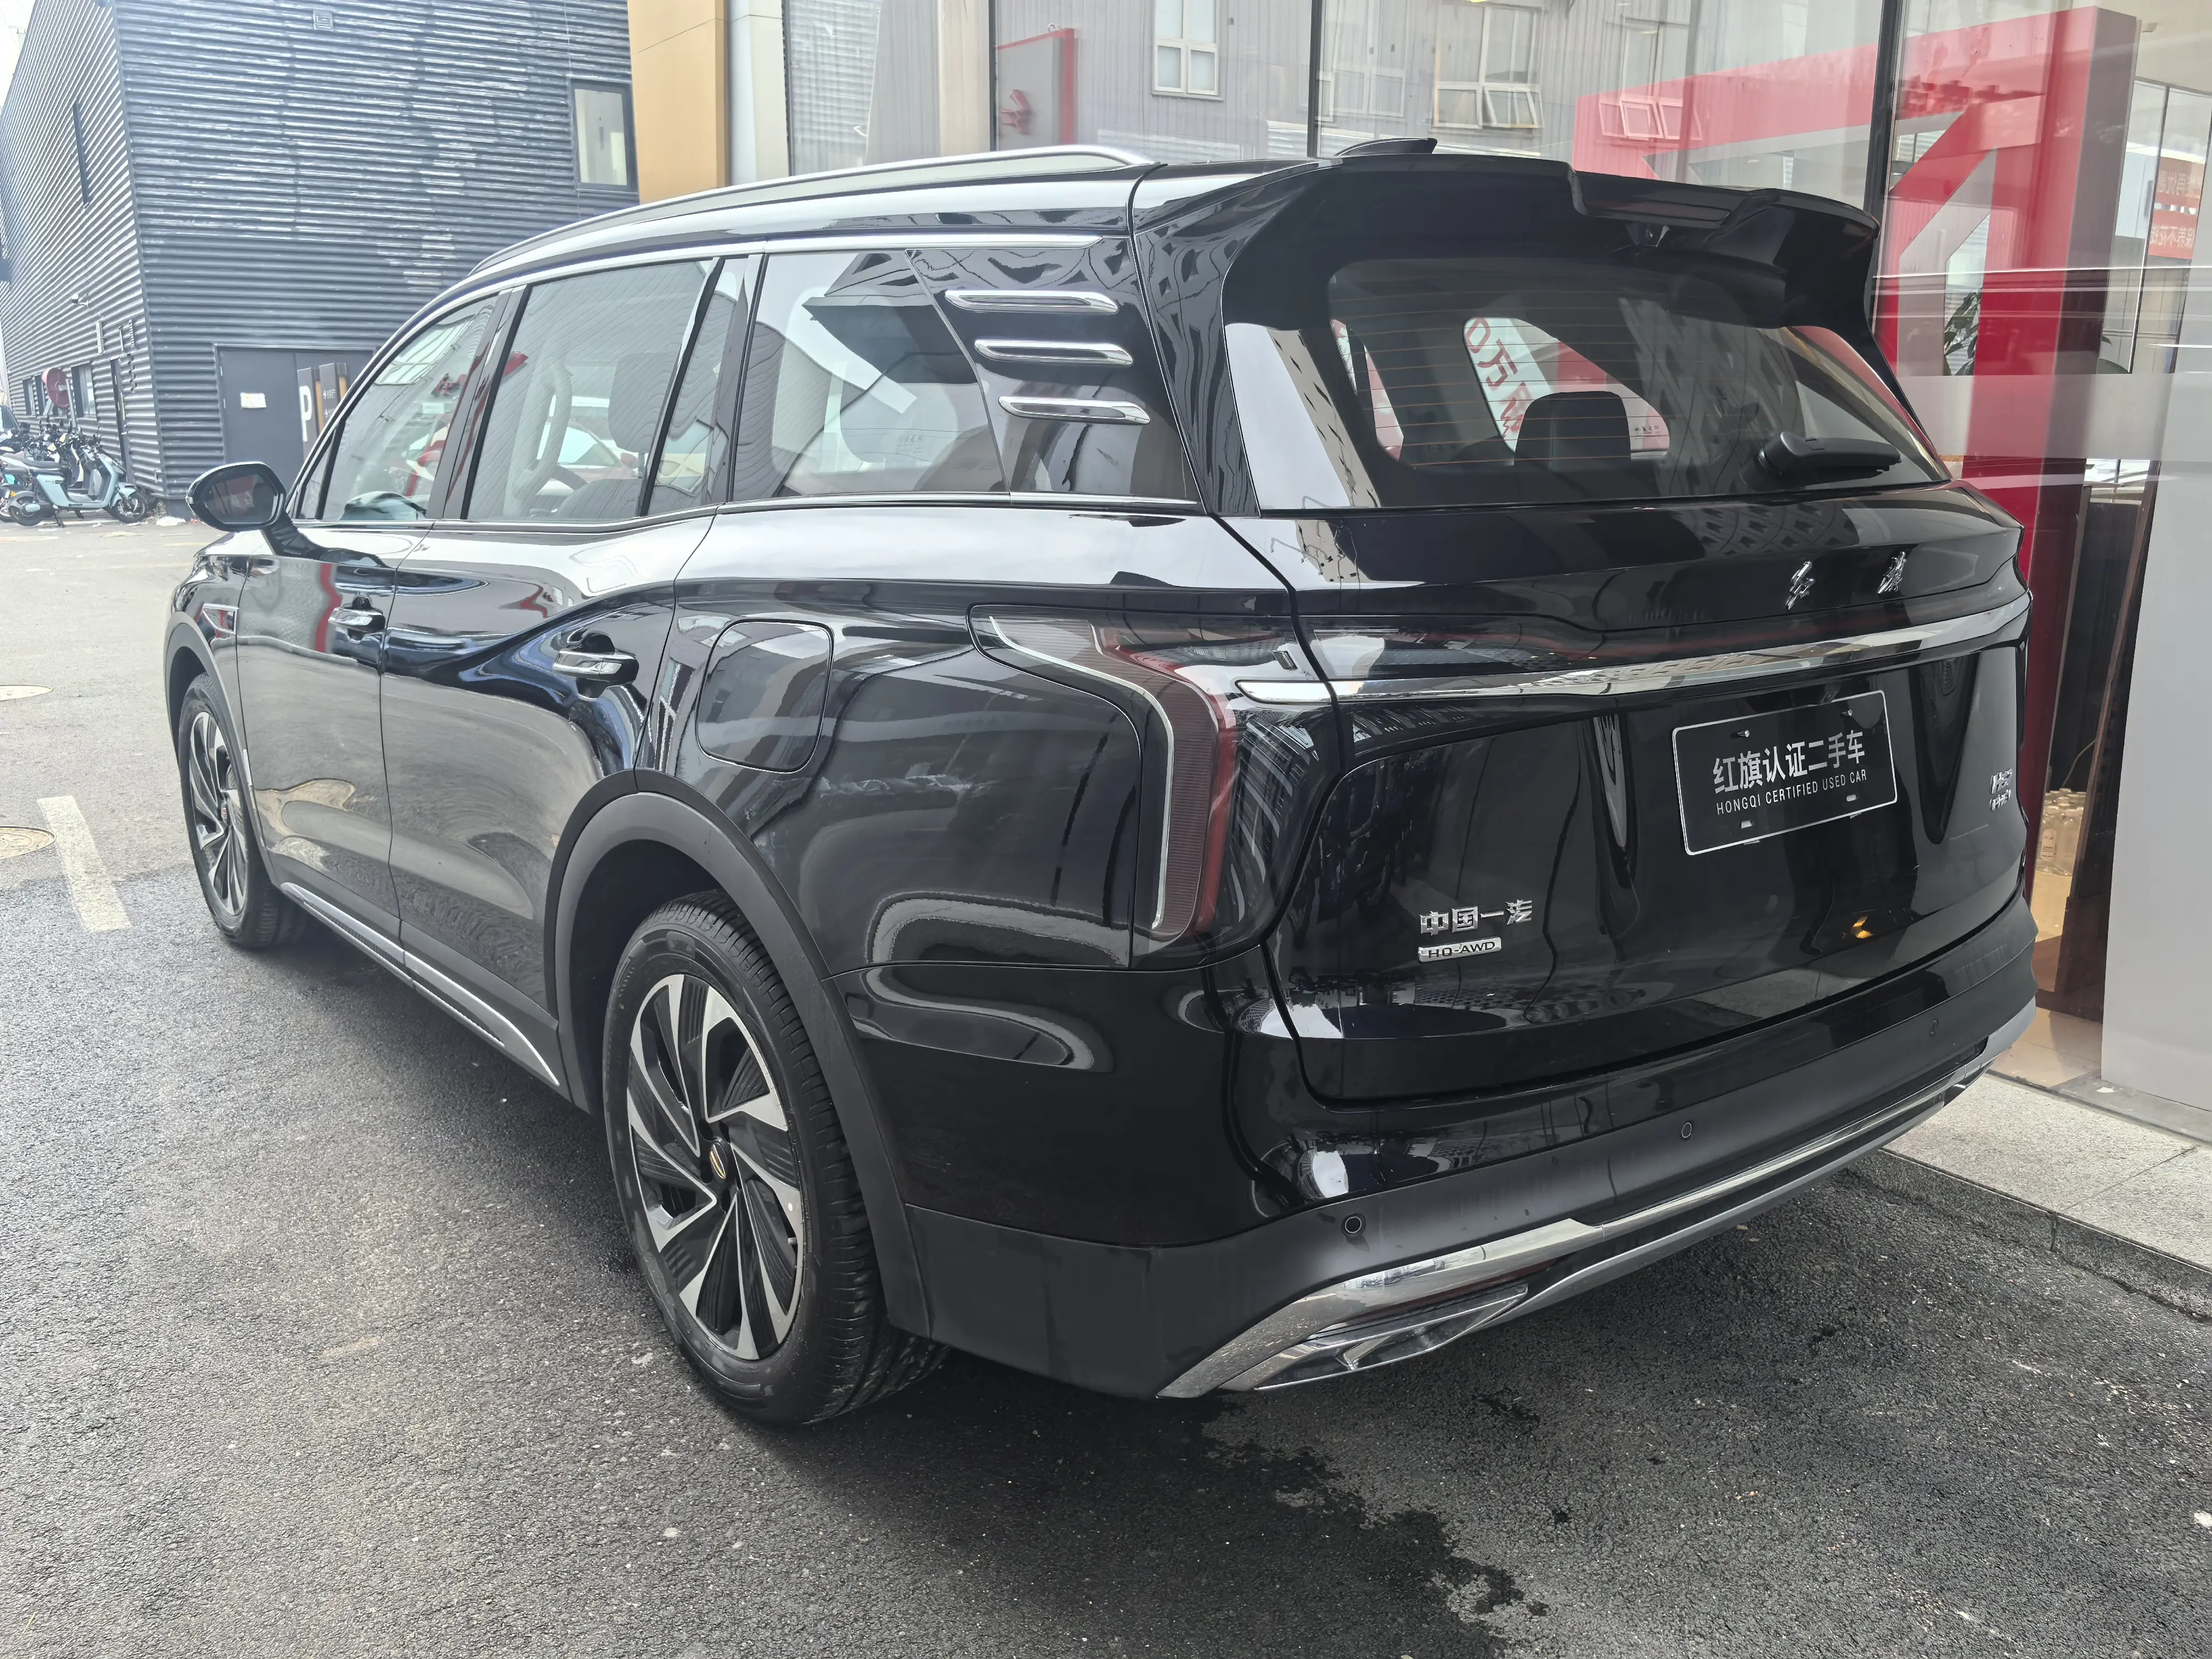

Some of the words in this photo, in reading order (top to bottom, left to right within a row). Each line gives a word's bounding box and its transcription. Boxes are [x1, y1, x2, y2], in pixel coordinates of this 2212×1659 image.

[299, 385, 312, 442] P
[1713, 730, 1865, 794] 红旗认证二手车
[1717, 794, 1760, 815] HONGQI
[1766, 781, 1818, 804] CERTIFIED
[1822, 774, 1846, 791] USED
[1850, 769, 1867, 784] CAR
[1420, 899, 1532, 936] 中国一汽
[1428, 941, 1495, 958] HQ-AWD
